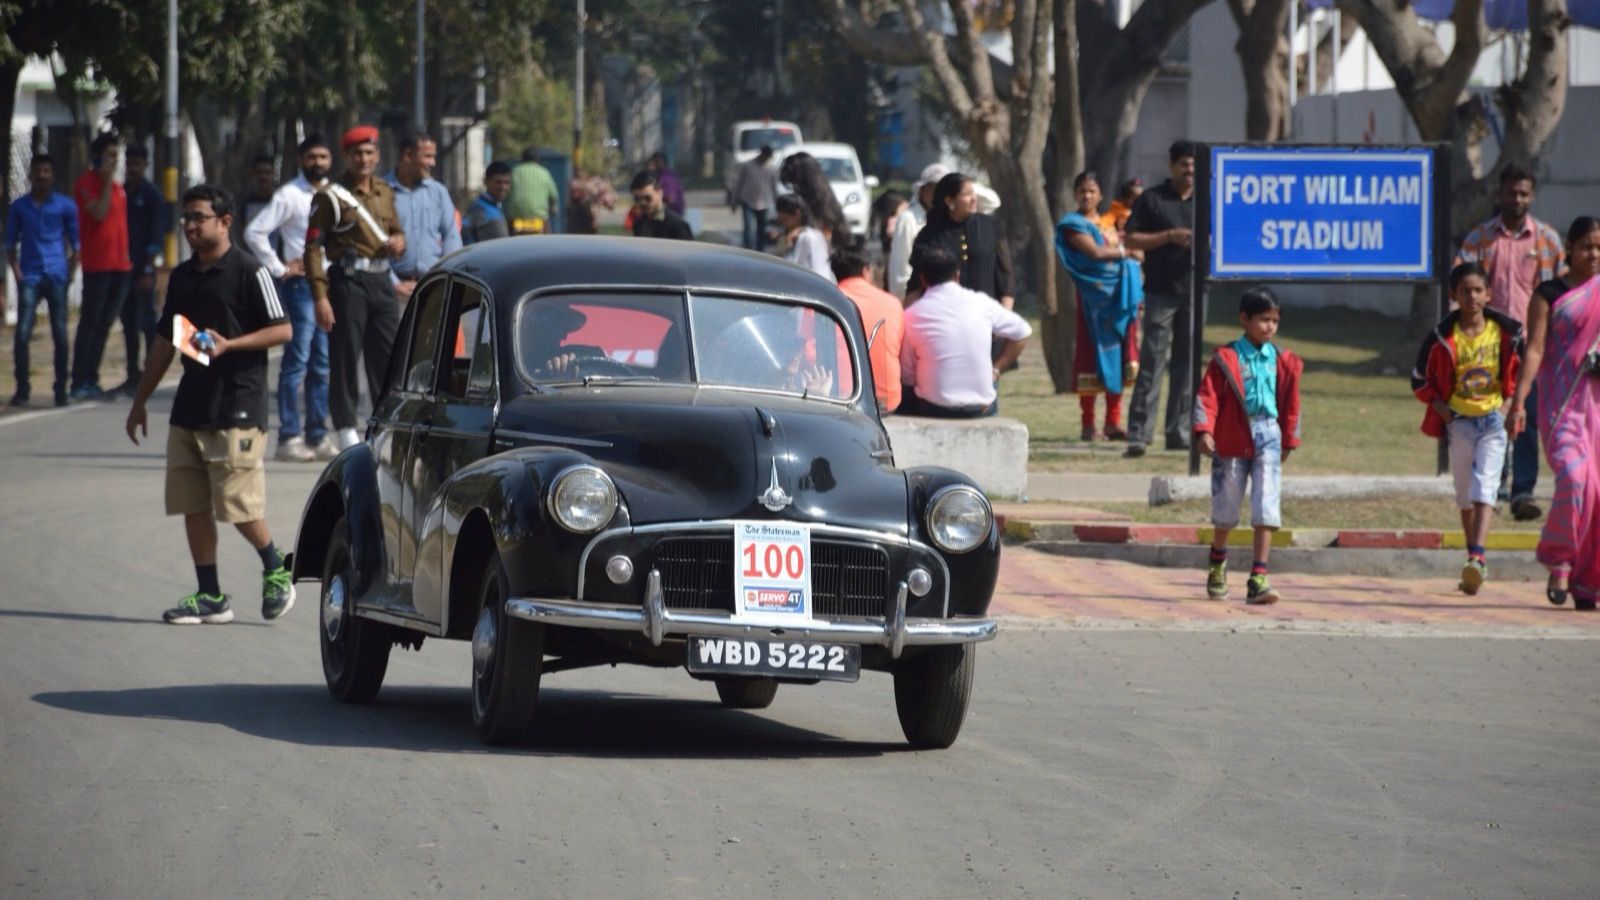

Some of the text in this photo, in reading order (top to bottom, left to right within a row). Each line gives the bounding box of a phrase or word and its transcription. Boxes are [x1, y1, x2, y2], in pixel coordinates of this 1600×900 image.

[1225, 175, 1420, 205] FORT WILLIAM
[1261, 219, 1383, 250] STADIUM
[745, 524, 801, 536] The Statesman
[743, 542, 804, 579] 100
[759, 592, 800, 604] SERVO 4T
[698, 639, 845, 672] WBD 5222
